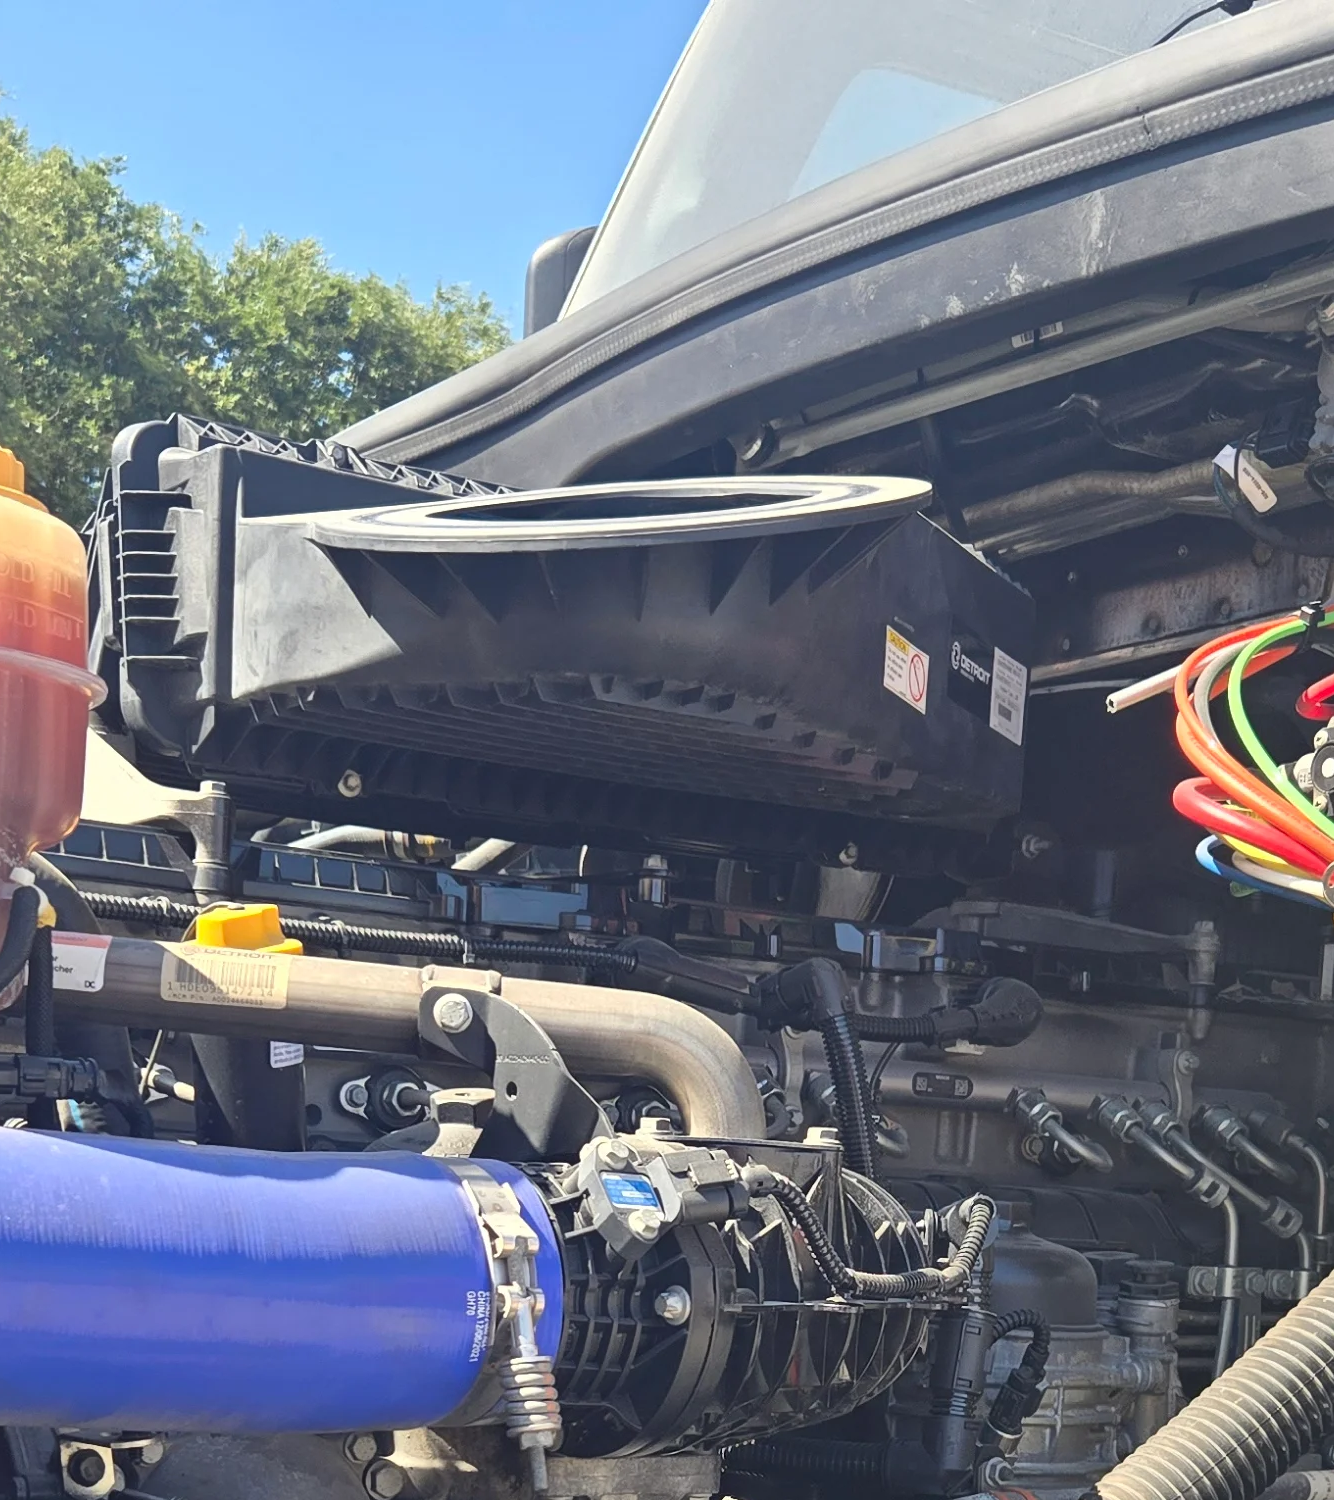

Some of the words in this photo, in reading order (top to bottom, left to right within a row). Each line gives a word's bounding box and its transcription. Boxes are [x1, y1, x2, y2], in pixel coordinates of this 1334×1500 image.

[960, 654, 991, 685] DETROIT
[204, 948, 276, 960] DETROIT
[84, 980, 96, 989] DC
[466, 1290, 476, 1316] GH70
[476, 1290, 486, 1319] CHINA
